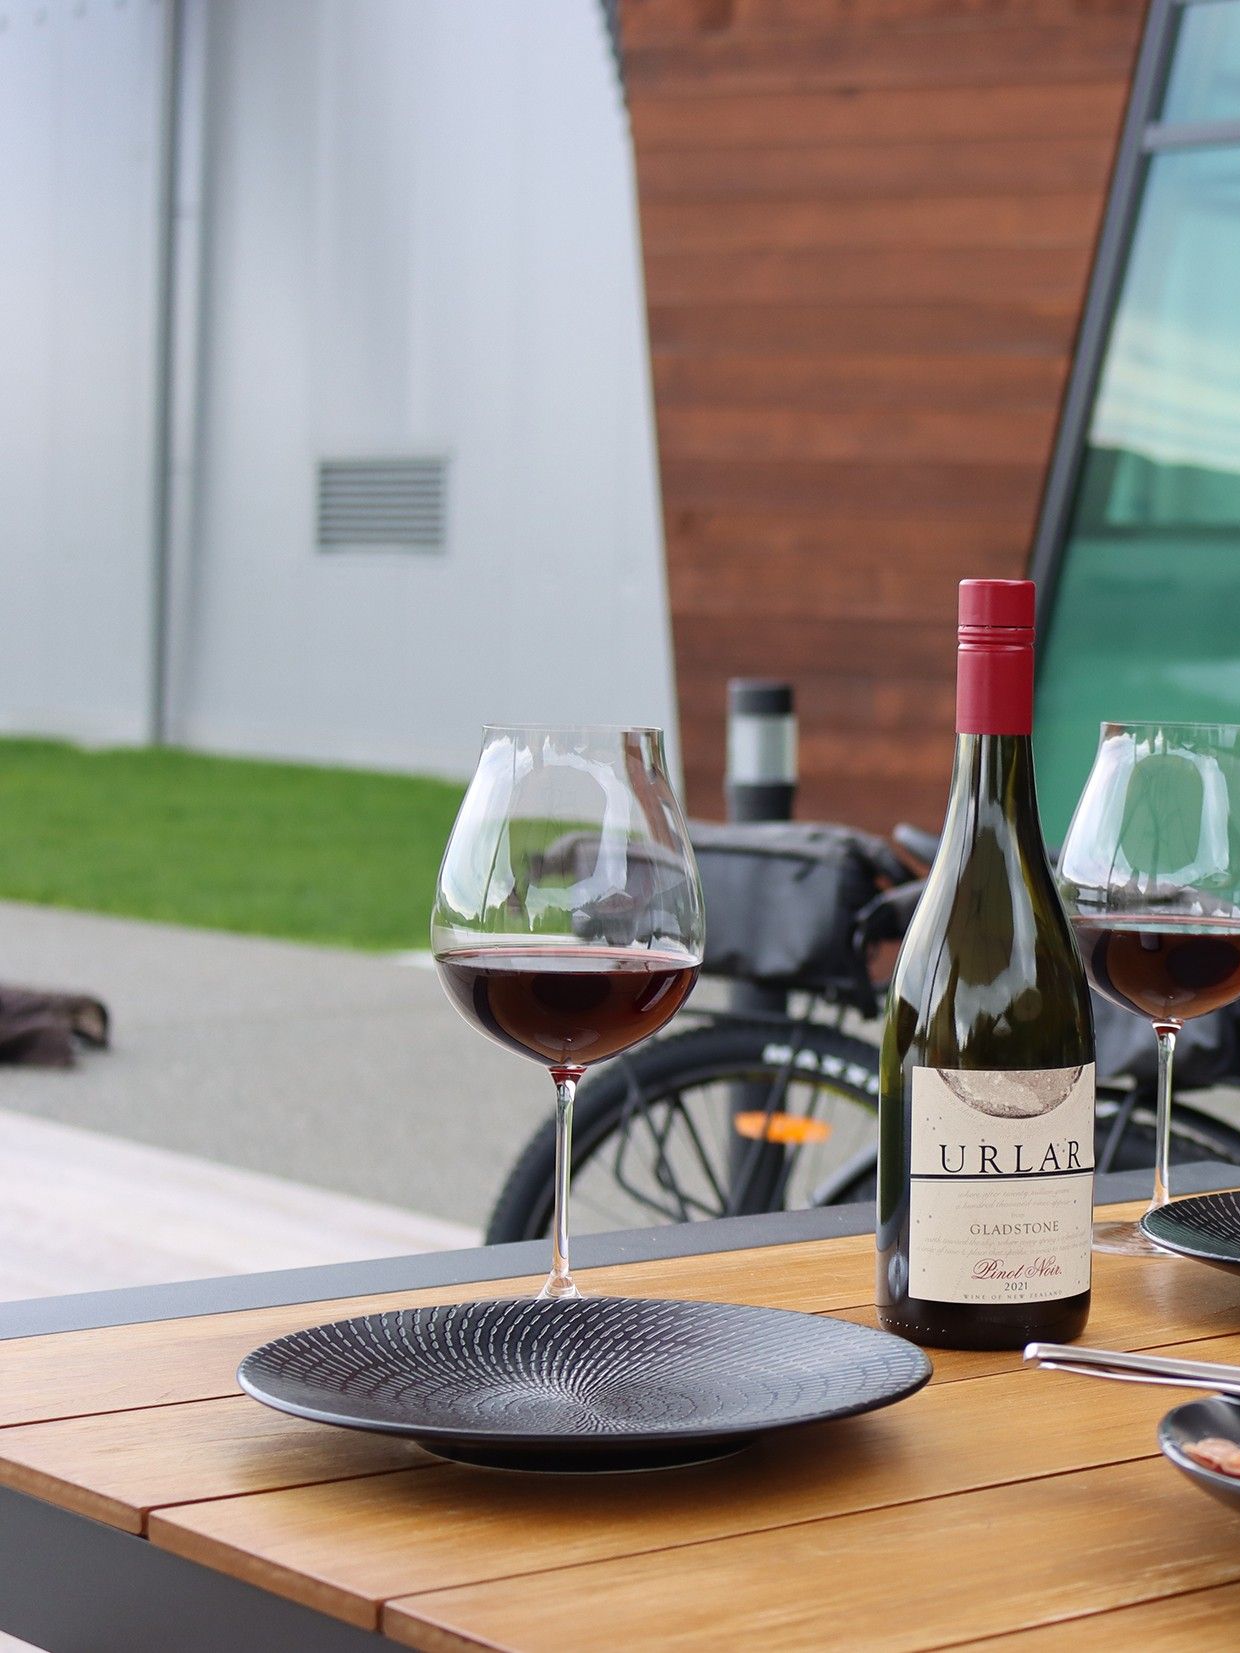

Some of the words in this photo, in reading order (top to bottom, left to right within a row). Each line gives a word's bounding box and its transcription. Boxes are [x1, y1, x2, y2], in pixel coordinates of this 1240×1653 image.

[938, 1140, 1082, 1174] URLAR
[969, 1220, 1059, 1236] GLADSTONE
[971, 1257, 1025, 1280] Pinot
[1004, 1281, 1029, 1292] 2021
[991, 1293, 1001, 1301] OF
[1029, 1290, 1063, 1299] ZEALAND
